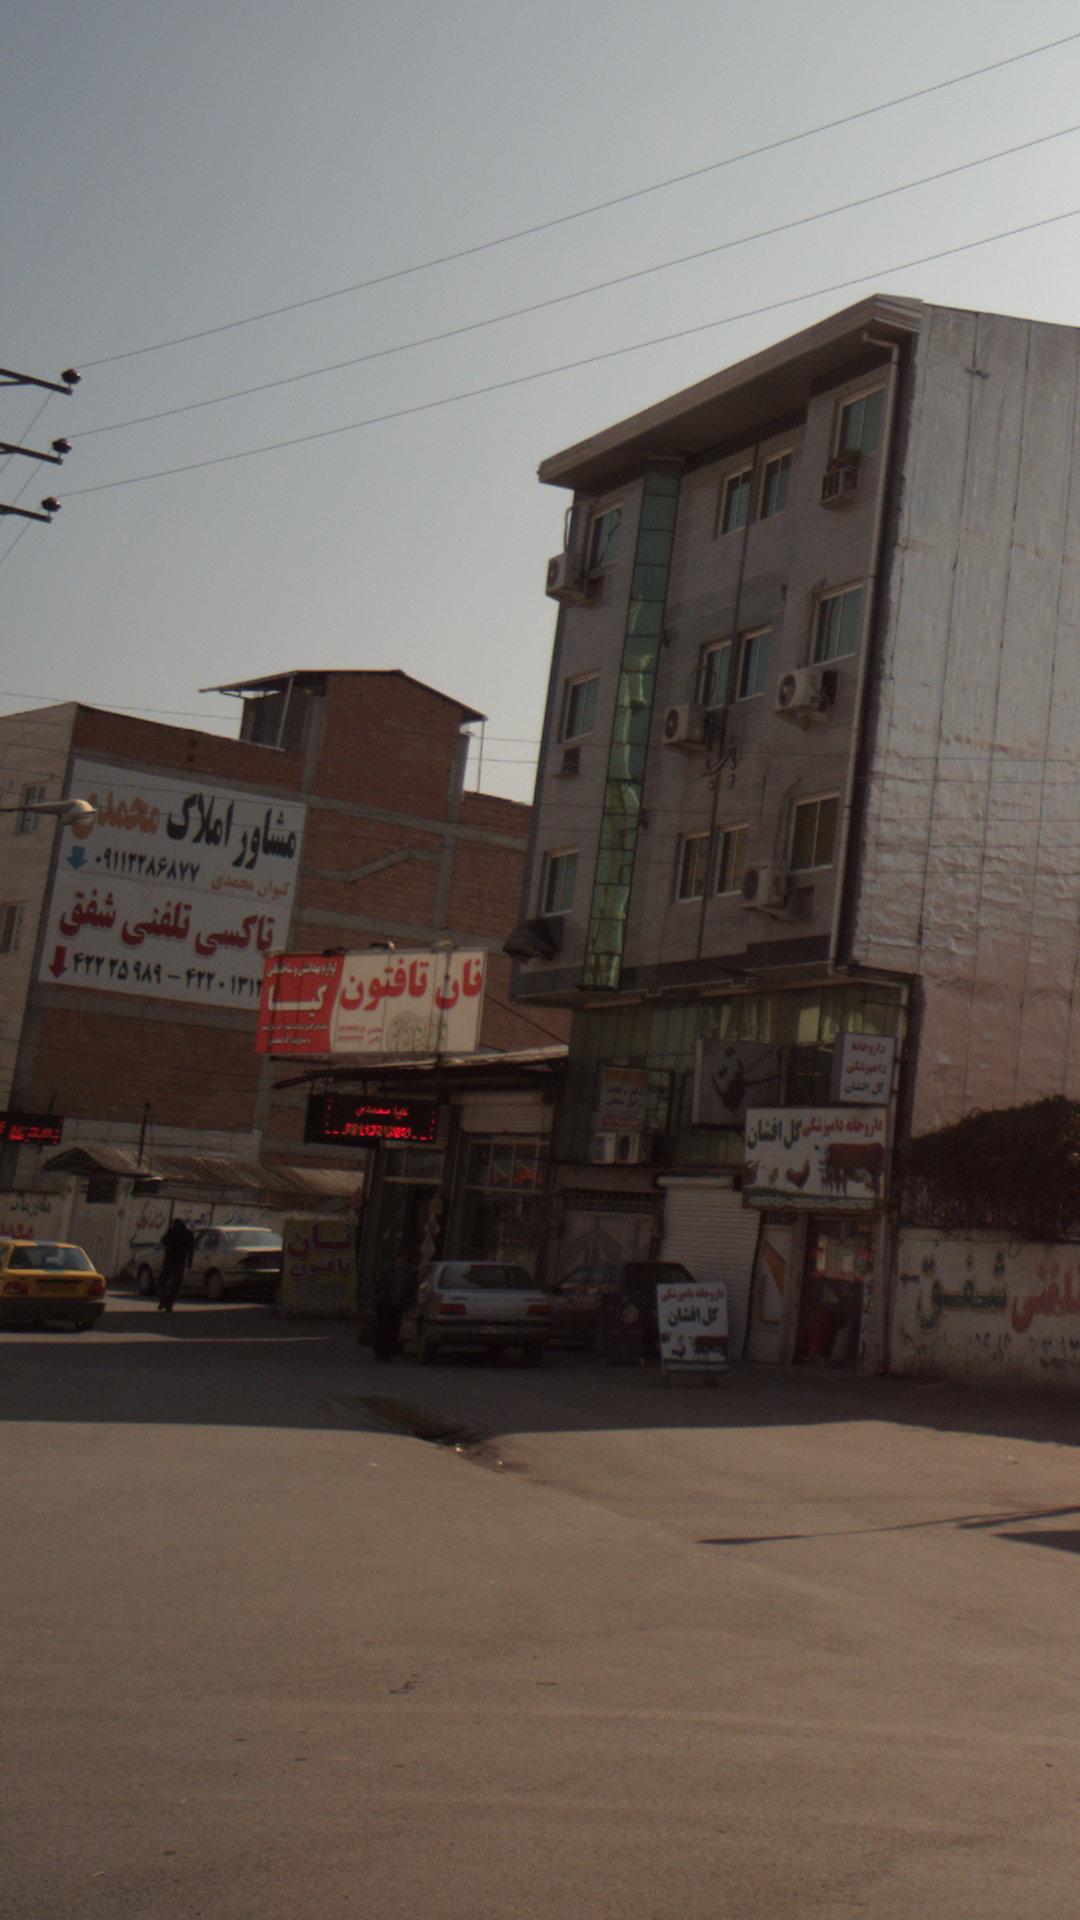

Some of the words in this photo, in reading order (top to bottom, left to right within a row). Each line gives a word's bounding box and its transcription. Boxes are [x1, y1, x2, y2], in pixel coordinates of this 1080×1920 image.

[166, 792, 235, 847] املاک
[232, 806, 297, 869] مشاور
[59, 889, 117, 936] شفق
[122, 901, 193, 946] تلفنی
[195, 914, 276, 957] تاکسی
[340, 957, 430, 1012] تافتون
[434, 959, 482, 1010] نان
[852, 1039, 887, 1056] داروخانه
[846, 1060, 888, 1075] دامپزشکی
[747, 1116, 783, 1150] افشان
[783, 1118, 804, 1150] گل
[801, 1115, 845, 1138] دامپزشکی
[846, 1116, 883, 1137] داروخانه
[287, 1219, 353, 1258] نان
[288, 1256, 352, 1278] تافتون
[661, 1287, 695, 1302] دامپزشکی
[695, 1287, 724, 1302] داروخانه
[668, 1305, 701, 1327] افشان
[702, 1306, 720, 1327] گل
